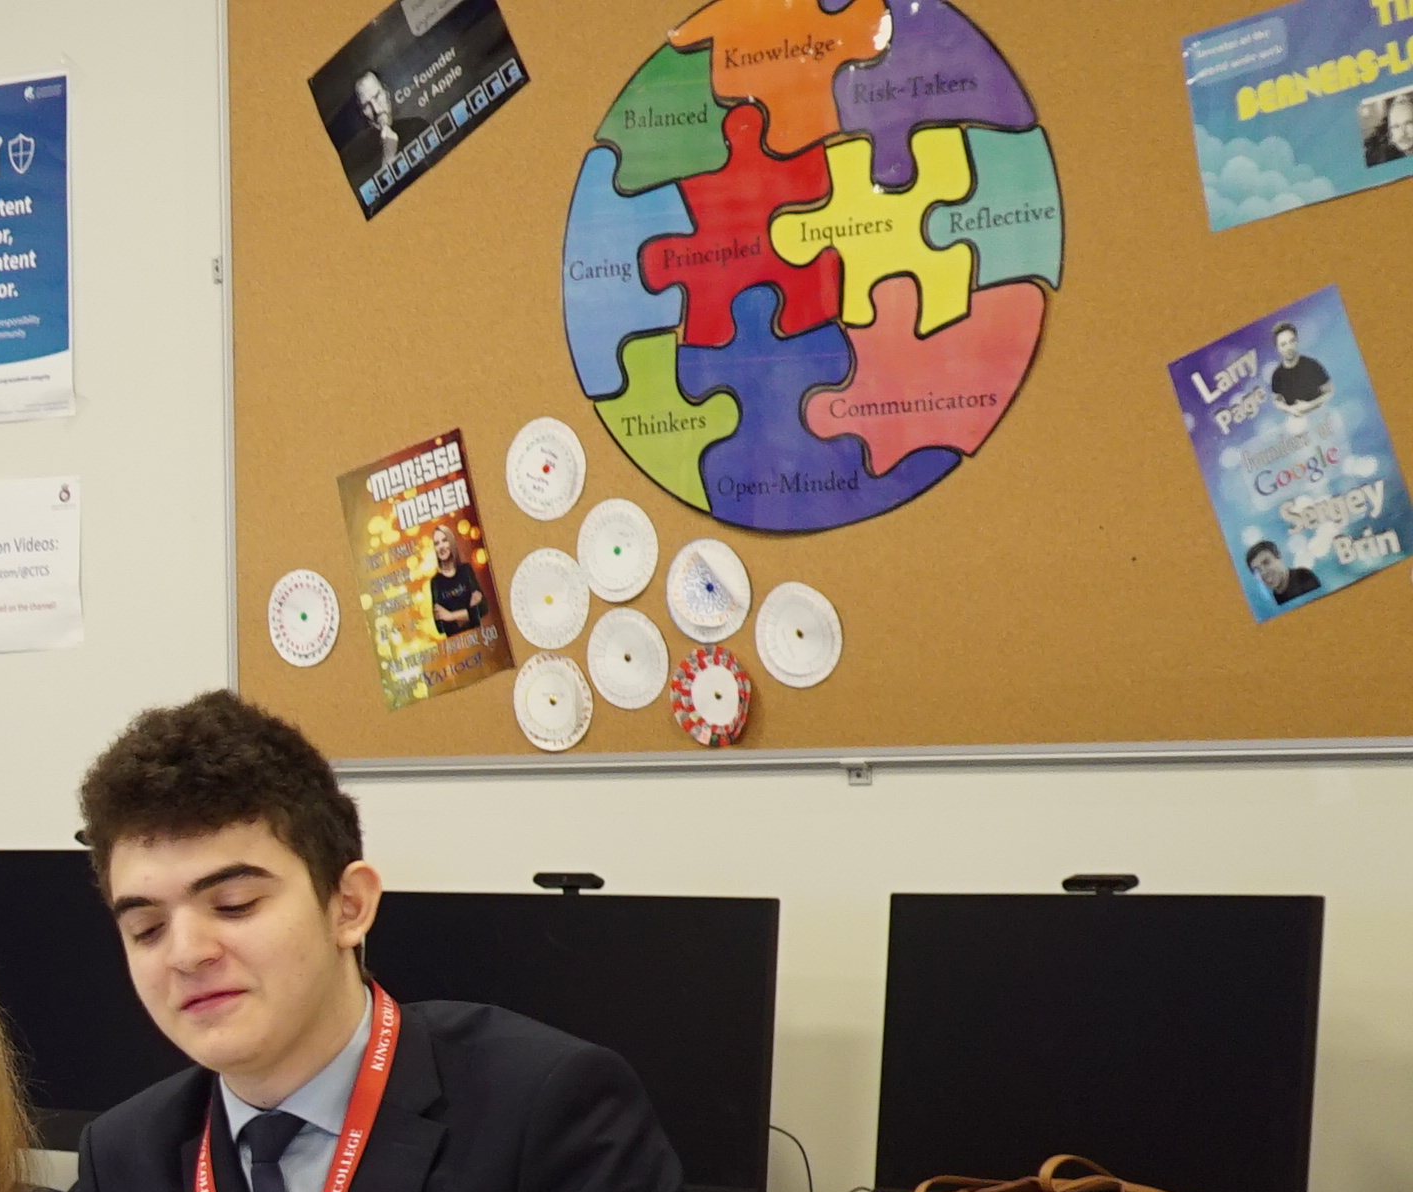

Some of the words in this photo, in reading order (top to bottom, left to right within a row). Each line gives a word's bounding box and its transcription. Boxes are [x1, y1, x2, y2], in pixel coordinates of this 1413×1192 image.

[1371, 0, 1413, 27] TI
[723, 34, 836, 70] Knowledge
[394, 47, 457, 105] Co-founder
[430, 65, 463, 98] Apple
[852, 73, 979, 105] Risk-Takers
[623, 105, 709, 130] Balanced
[799, 217, 894, 244] Inquirers
[948, 202, 1057, 234] Reflective
[662, 236, 762, 270] Principled
[568, 259, 632, 282] Caring
[1191, 348, 1259, 404] Larry
[829, 389, 998, 420] Communicators
[621, 412, 707, 438] Thinkers
[1253, 446, 1339, 497] Google
[716, 474, 861, 508] Open-Minded
[1279, 478, 1385, 535] Sergey
[14, 536, 60, 553] Videos:
[1333, 526, 1401, 565] Brin
